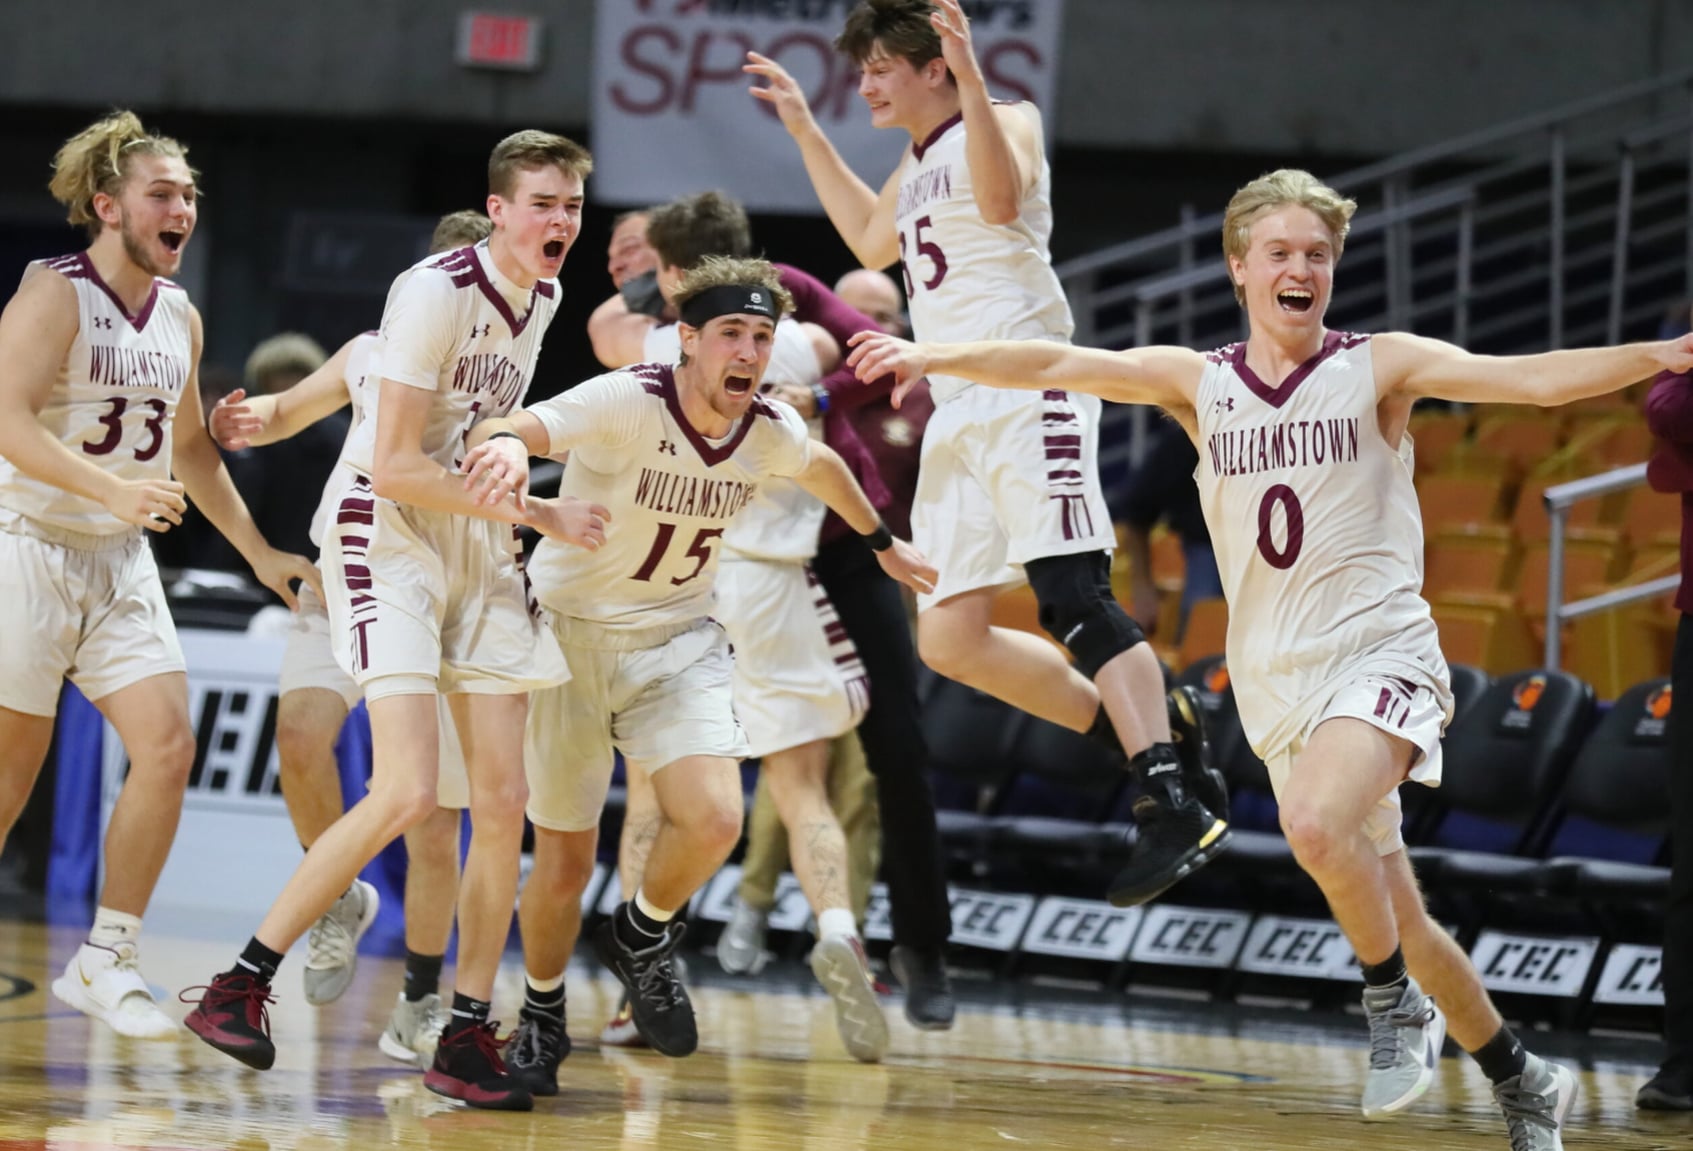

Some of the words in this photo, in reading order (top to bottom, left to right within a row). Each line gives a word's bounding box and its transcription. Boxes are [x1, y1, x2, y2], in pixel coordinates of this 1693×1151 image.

[82, 396, 168, 462] 33
[1208, 417, 1358, 477] WILLIAMSTOWN
[1256, 483, 1305, 570] 0
[628, 522, 725, 586] 15
[1041, 909, 1126, 946] CEC
[1151, 917, 1233, 956] CEC
[1257, 927, 1341, 964] CEC
[1483, 942, 1579, 982] CEC
